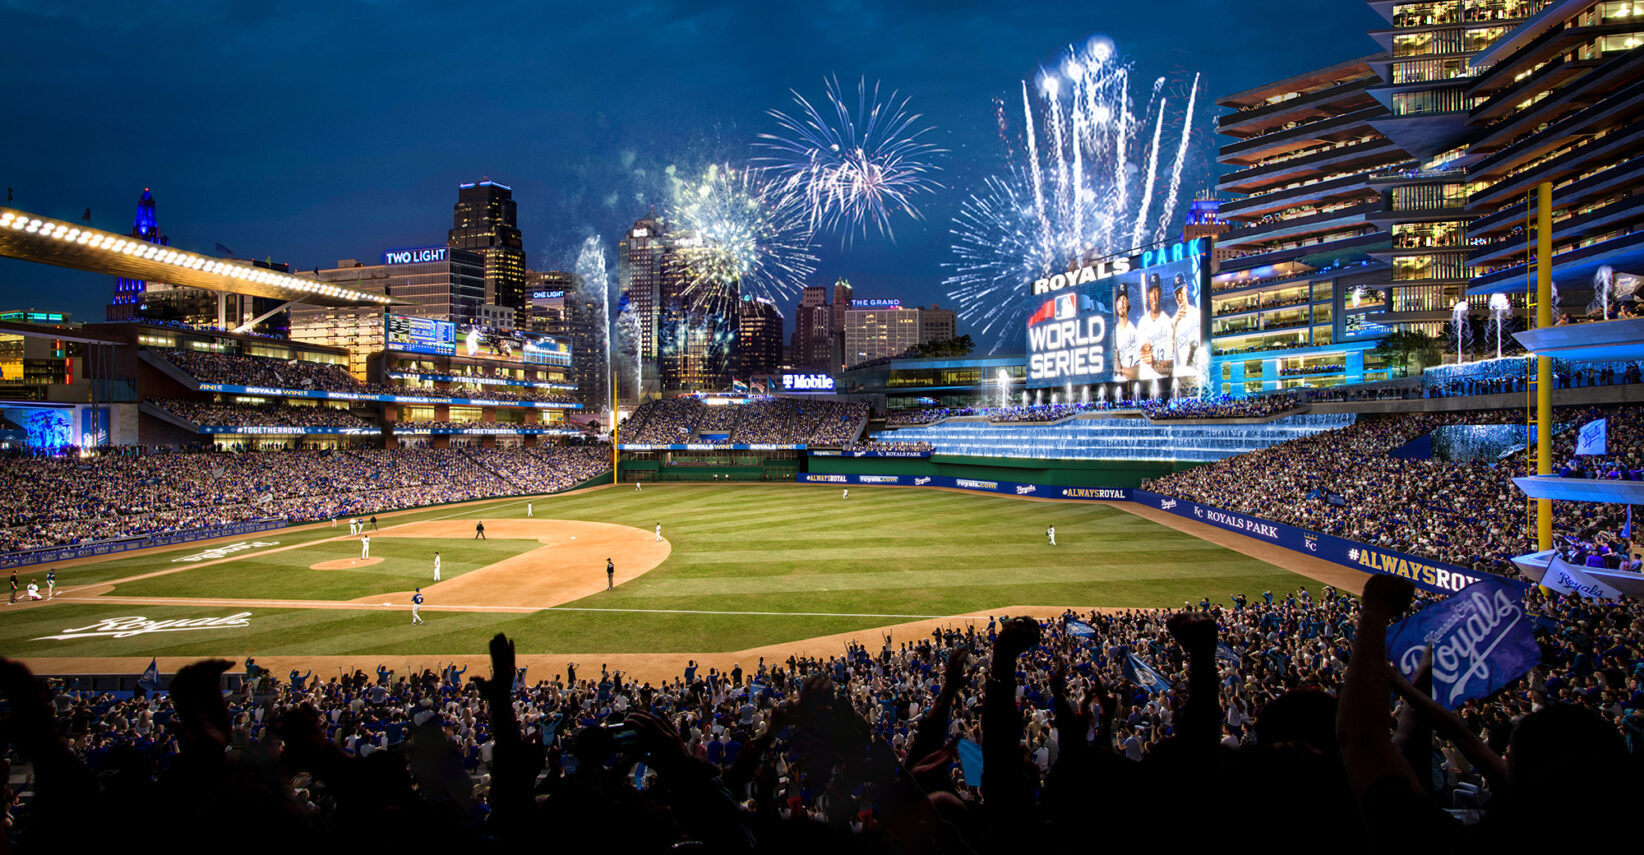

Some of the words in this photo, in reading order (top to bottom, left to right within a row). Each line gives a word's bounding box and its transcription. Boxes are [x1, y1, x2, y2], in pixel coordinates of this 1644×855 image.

[386, 251, 412, 265] TWO
[413, 248, 446, 264] LIGHT
[1034, 257, 1131, 294] ROYALS
[1142, 238, 1201, 268] PARK
[546, 290, 564, 299] LIGHT
[1029, 315, 1105, 353] WORLD
[1031, 345, 1103, 379] SERIES
[246, 387, 282, 395] ROYALS
[328, 391, 359, 399] ROYALS
[236, 426, 306, 434] #TOGETHERROYAL
[806, 474, 847, 483] #ALWAYSROYAL
[859, 475, 898, 483] royals.com
[957, 479, 997, 489] royals.com
[1016, 484, 1036, 495] Royals
[1062, 488, 1126, 499] #ALWAYSROYAL
[1161, 498, 1177, 510] Royals
[1194, 506, 1203, 518] KC
[1207, 510, 1244, 529] ROYALS
[1247, 520, 1279, 539] PARK
[1305, 539, 1317, 551] KC
[1558, 572, 1604, 597] Royals
[27, 612, 252, 641] Royals
[1400, 588, 1522, 704] Royals
